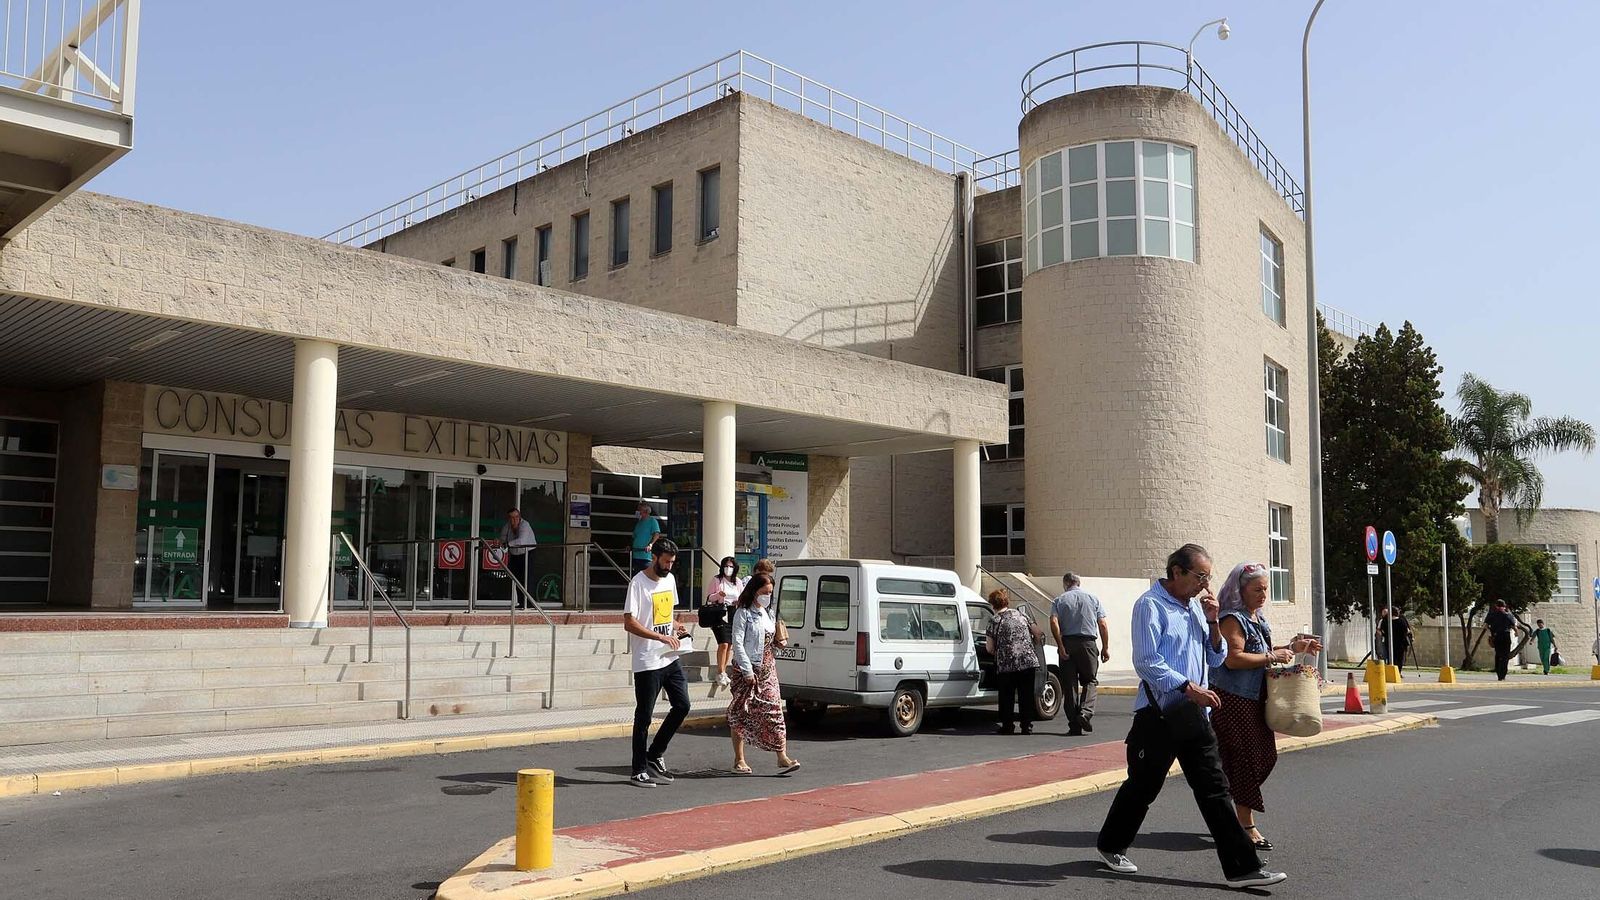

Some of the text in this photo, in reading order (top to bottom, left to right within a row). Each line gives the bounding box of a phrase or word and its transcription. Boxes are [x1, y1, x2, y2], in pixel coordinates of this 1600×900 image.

[156, 389, 561, 466] CONSUAS EXTERNAS
[163, 551, 196, 559] ENTRADA
